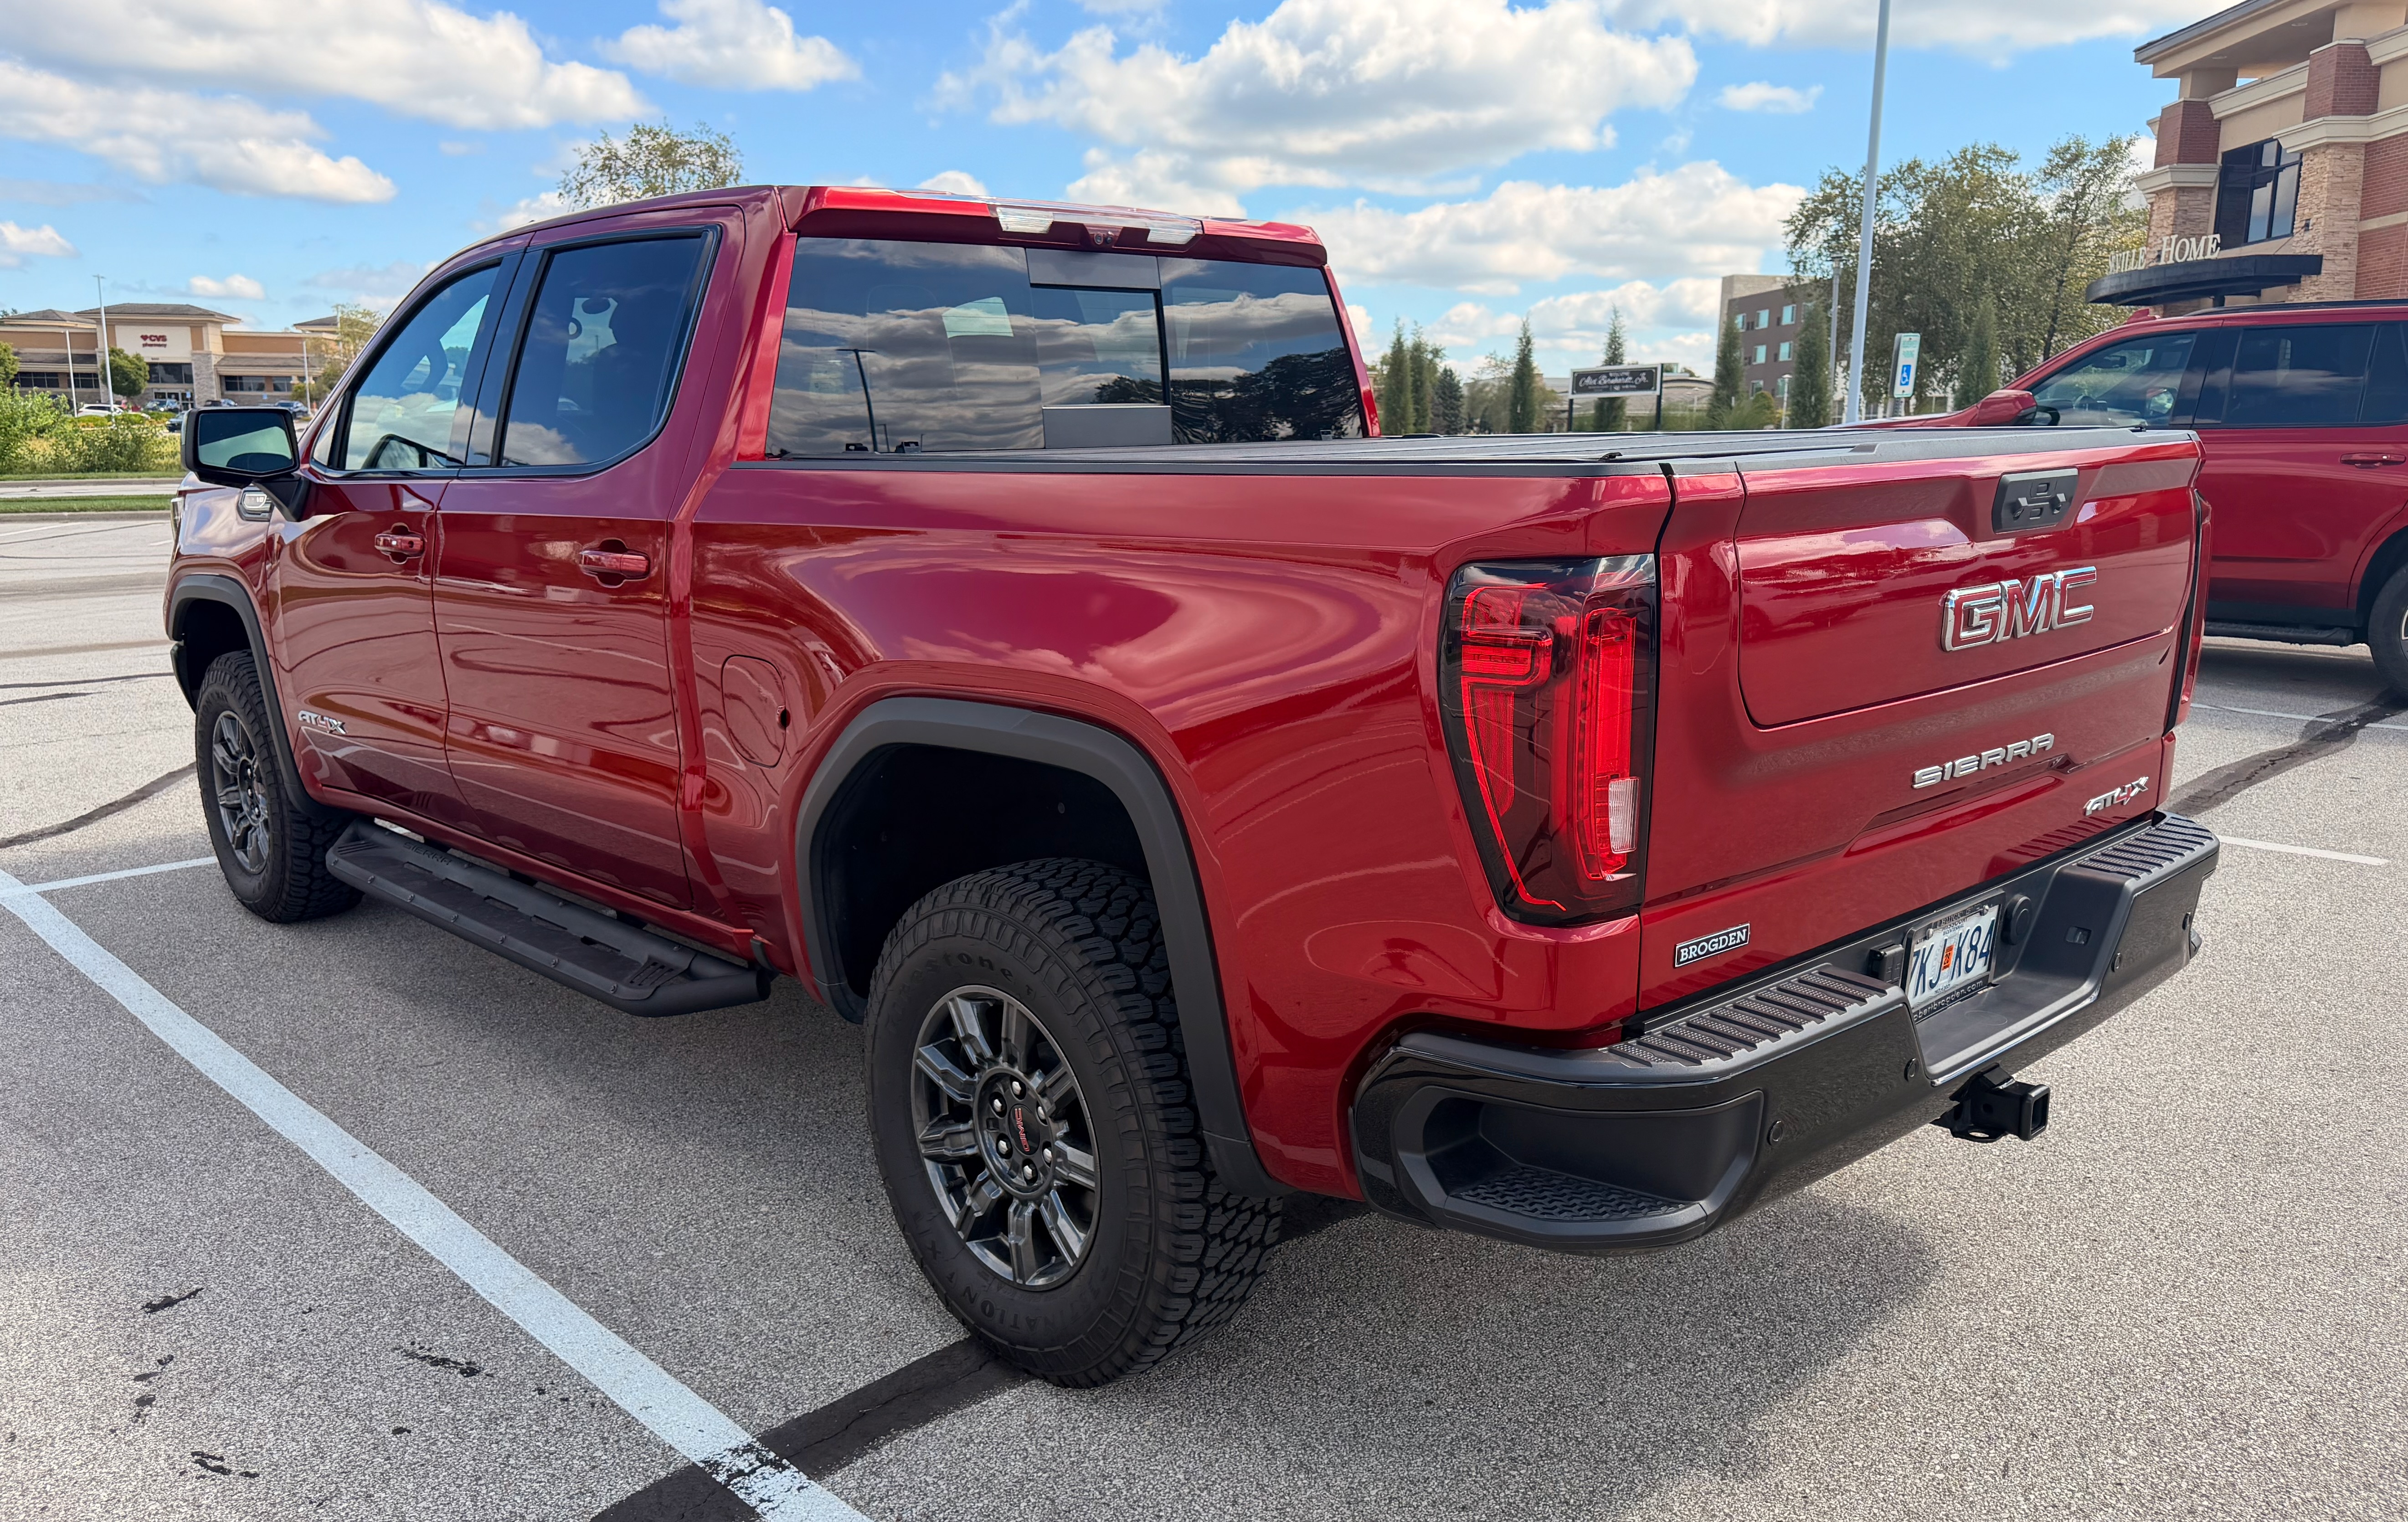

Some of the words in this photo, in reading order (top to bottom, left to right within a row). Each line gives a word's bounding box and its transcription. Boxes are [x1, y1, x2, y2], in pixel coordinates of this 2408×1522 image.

[2158, 234, 2220, 265] HOME
[1940, 566, 2096, 652] GMC
[298, 710, 346, 735] AT4X
[1911, 733, 2054, 789] SIERRA
[2083, 776, 2149, 816] AT4X
[403, 842, 452, 866] SIERRA
[1680, 929, 1747, 962] BROGDEN
[1914, 980, 1983, 1021] obertbrogden.com
[1014, 1108, 1030, 1152] GMC
